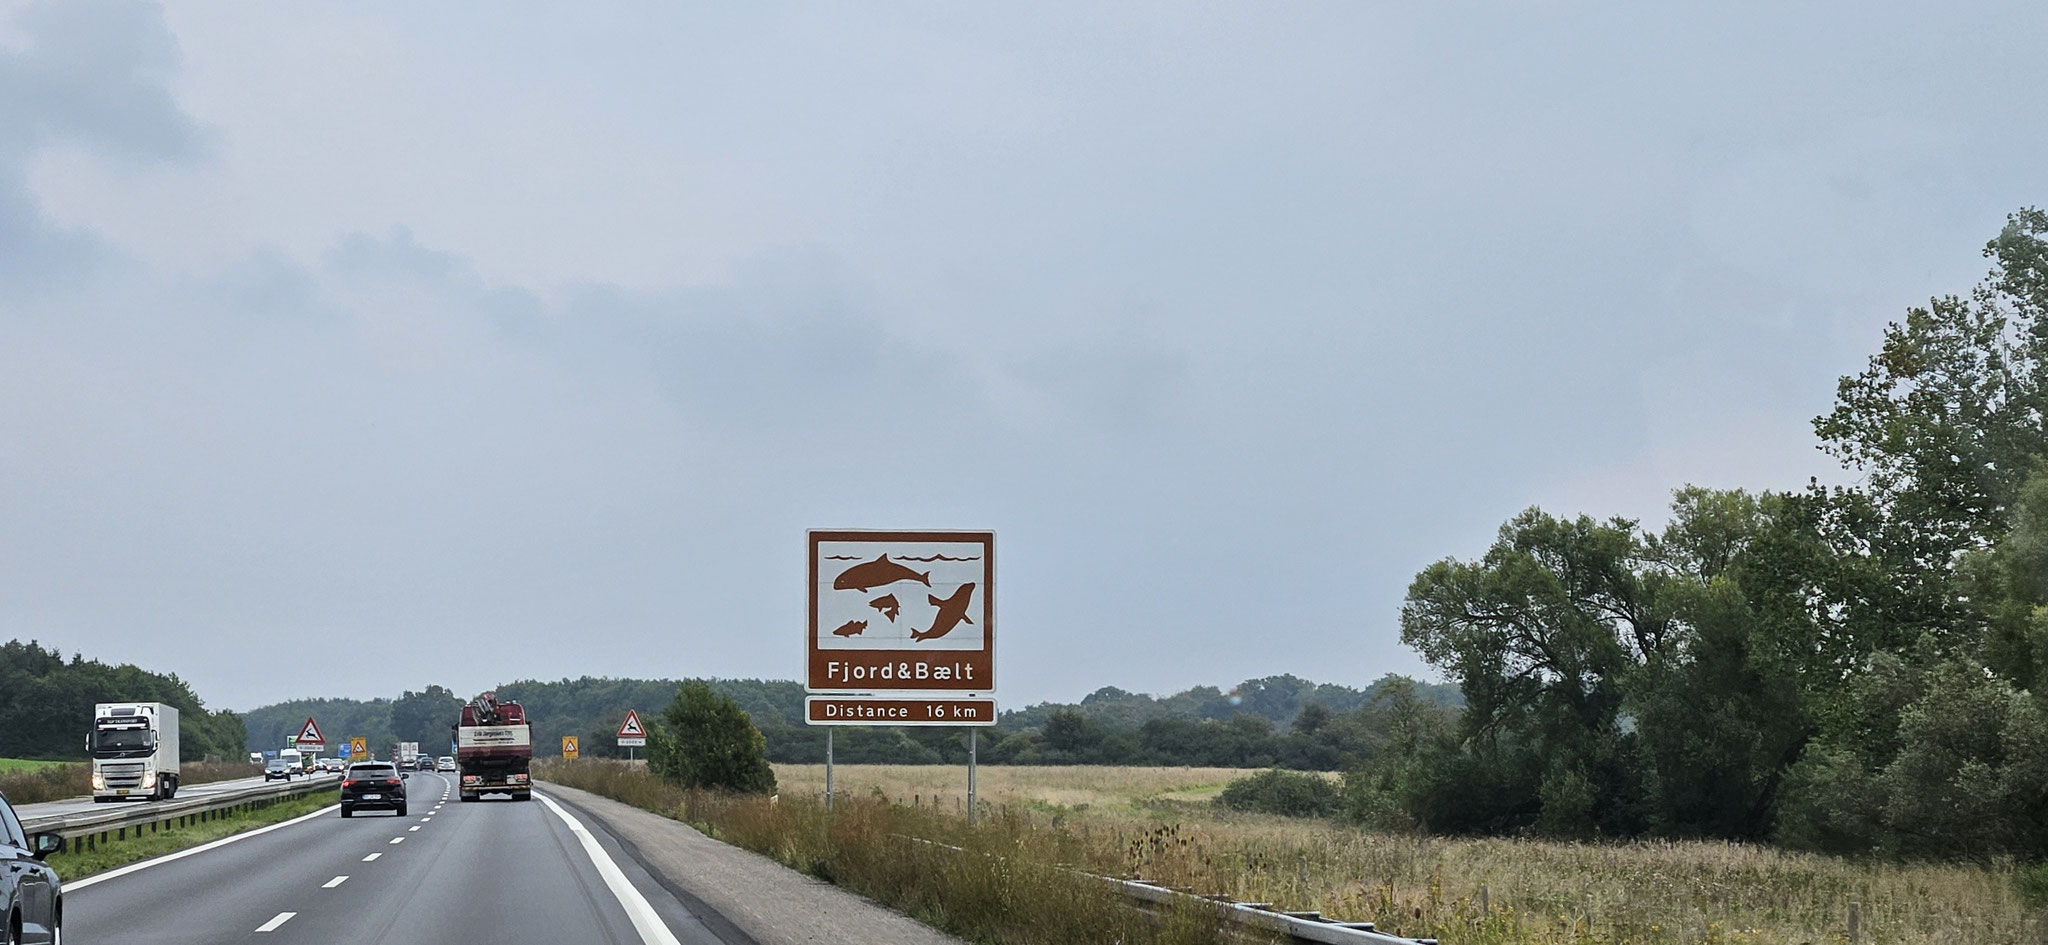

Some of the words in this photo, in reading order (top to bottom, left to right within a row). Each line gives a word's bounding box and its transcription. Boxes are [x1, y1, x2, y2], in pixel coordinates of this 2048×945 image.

[828, 661, 974, 682] Fjord&Bælt
[826, 704, 908, 718] Distance
[926, 704, 948, 718] 16
[954, 704, 977, 718] km
